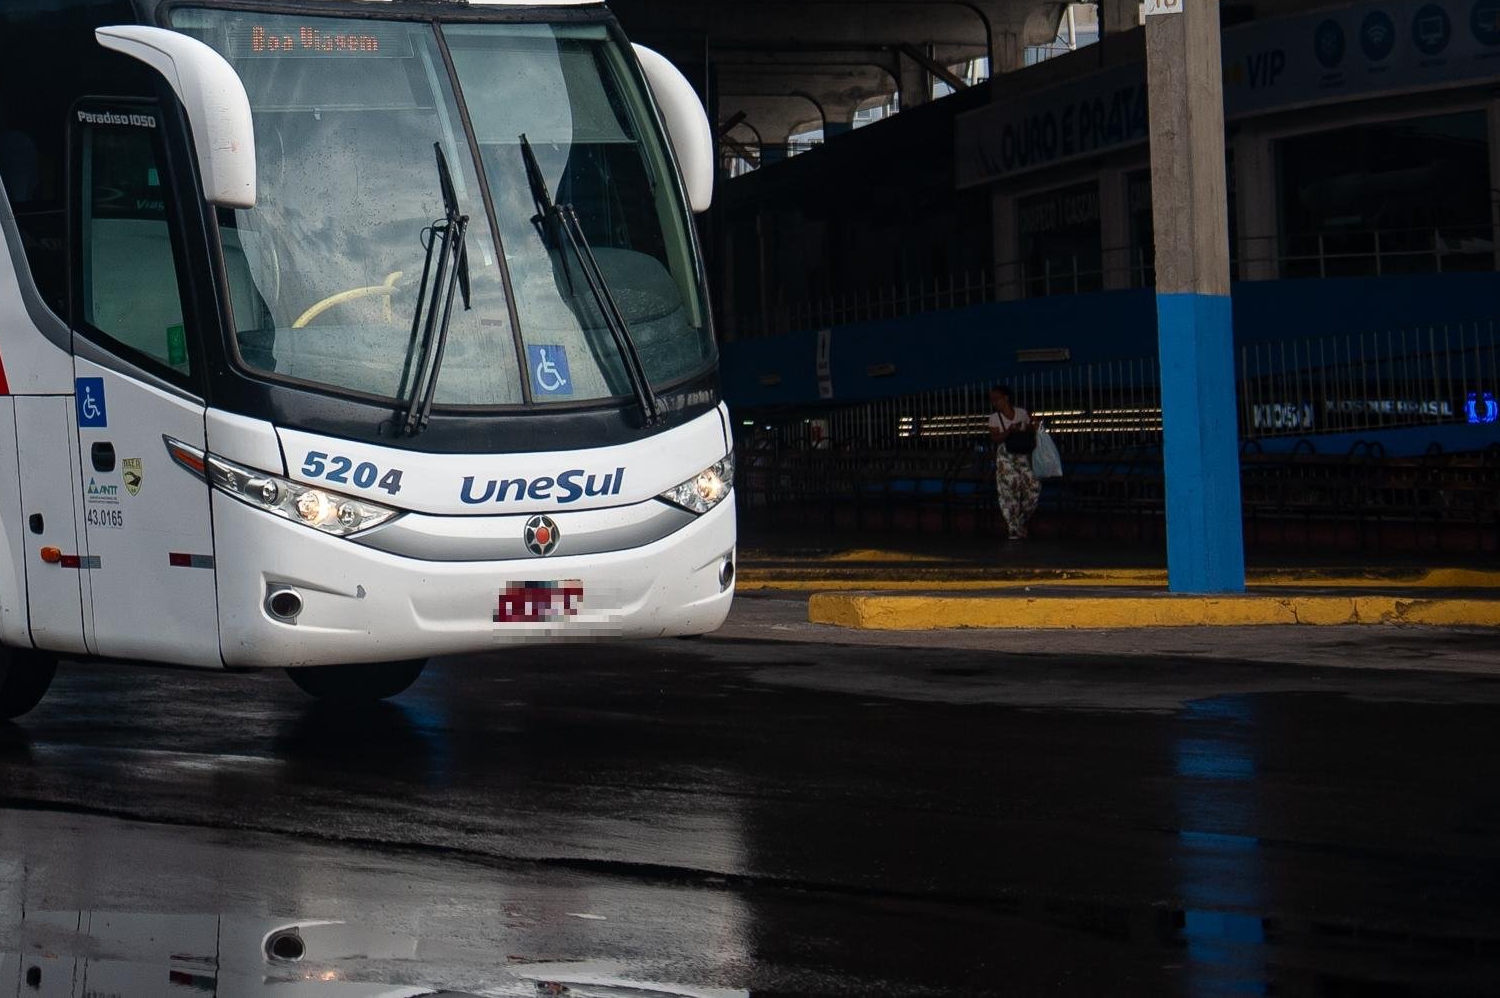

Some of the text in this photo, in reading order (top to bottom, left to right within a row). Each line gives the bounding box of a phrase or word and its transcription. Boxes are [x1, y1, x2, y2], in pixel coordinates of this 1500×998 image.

[252, 26, 293, 51] Boa
[1246, 49, 1285, 90] VIP
[77, 110, 156, 128] Paradiso 1050
[1002, 110, 1057, 171] OURO
[301, 450, 404, 496] 5204
[100, 485, 118, 495] ANTT
